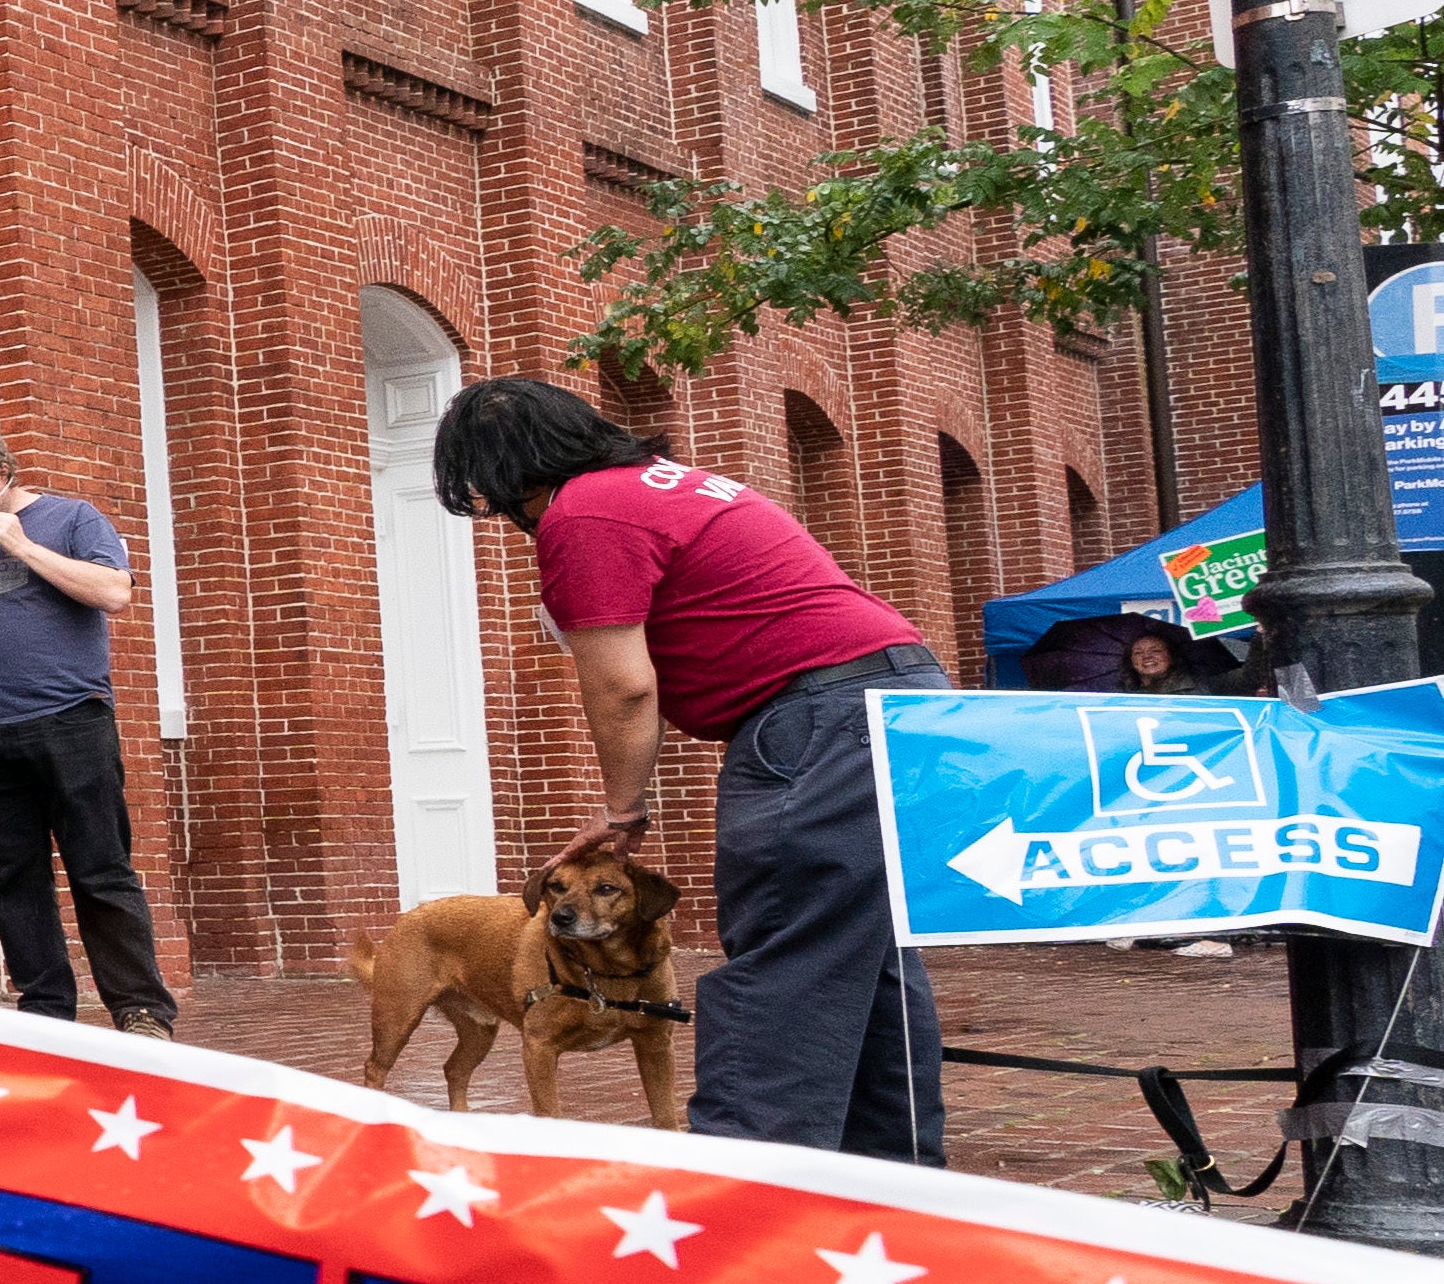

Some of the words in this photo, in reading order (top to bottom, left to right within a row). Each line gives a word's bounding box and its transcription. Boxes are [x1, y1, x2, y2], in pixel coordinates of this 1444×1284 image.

[1379, 381, 1444, 410] 44
[1384, 423, 1407, 435] ay
[1410, 420, 1436, 433] by
[1385, 436, 1444, 451] arking
[1394, 478, 1444, 490] ParkMo
[1196, 548, 1267, 579] Jacint
[1177, 563, 1268, 600] Gree
[1019, 822, 1380, 882] ACCESS
